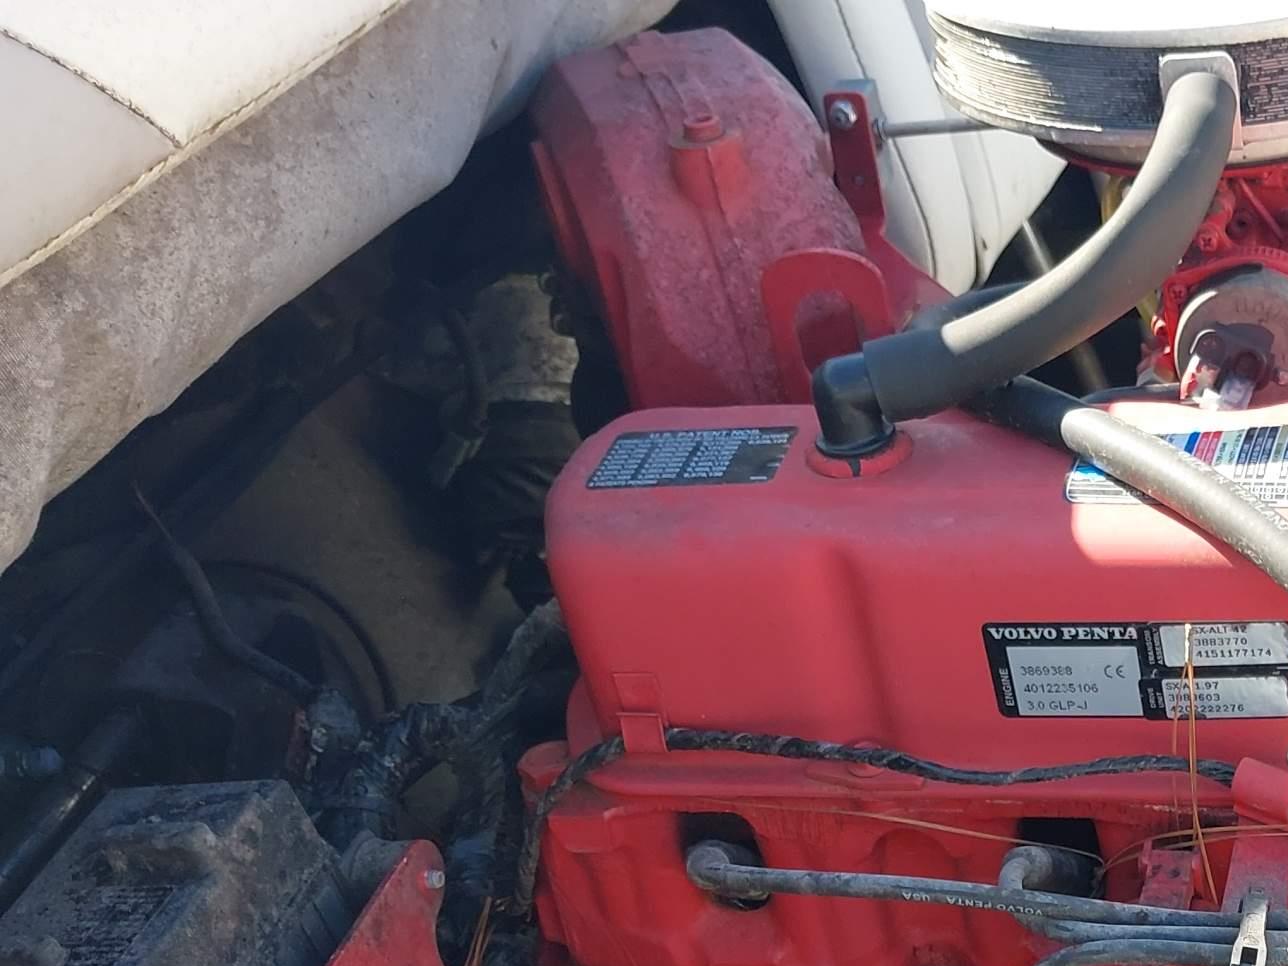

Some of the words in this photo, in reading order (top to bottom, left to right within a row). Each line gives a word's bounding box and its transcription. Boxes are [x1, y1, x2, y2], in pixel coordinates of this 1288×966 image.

[987, 627, 1058, 640] VOLVO
[1061, 626, 1138, 640] PENTA
[999, 668, 1015, 707] ENGINE
[1027, 700, 1046, 711] 3.0
[902, 891, 931, 902] USA
[946, 895, 993, 909] PENTA
[996, 903, 1043, 916] VOLVO
